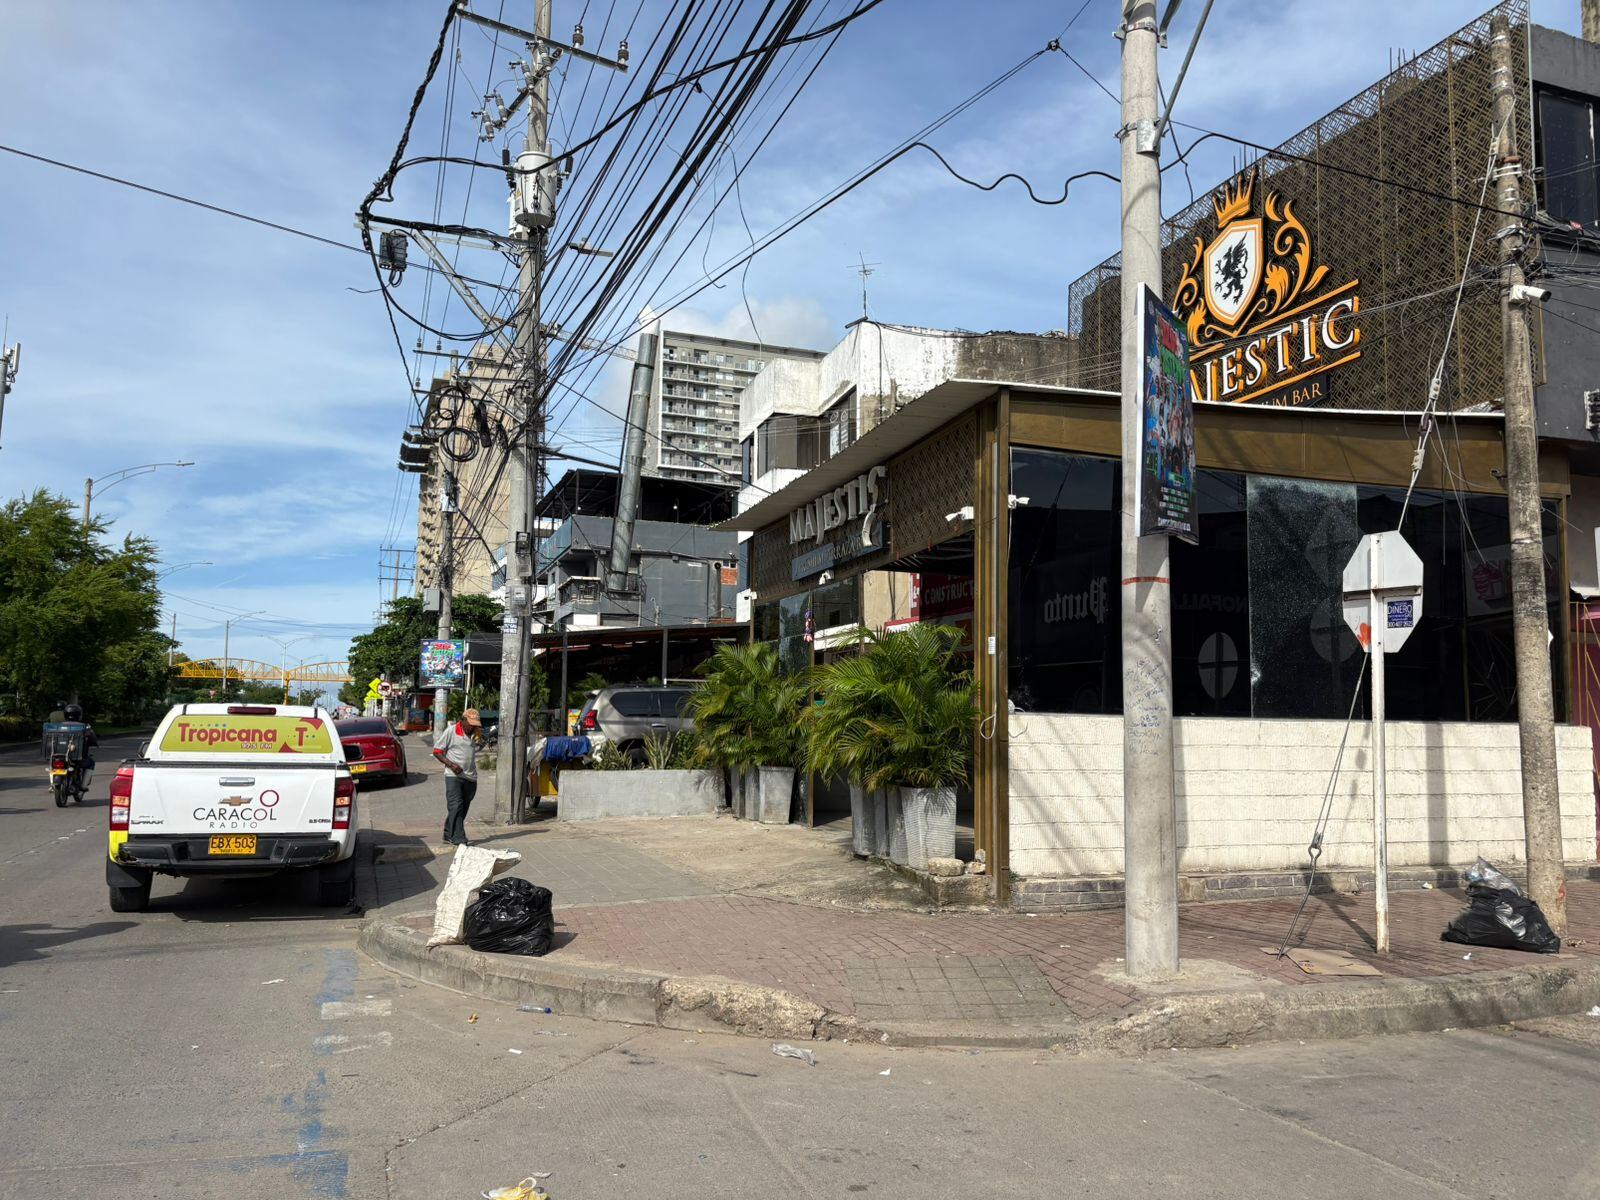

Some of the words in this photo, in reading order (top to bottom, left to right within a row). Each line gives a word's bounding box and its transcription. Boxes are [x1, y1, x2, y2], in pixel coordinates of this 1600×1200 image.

[1293, 382, 1323, 405] BAR
[1387, 605, 1412, 614] DINERO
[178, 722, 277, 745] Tropicana
[193, 807, 277, 821] CARACOL
[211, 836, 231, 849] EBX
[234, 836, 255, 849] 503
